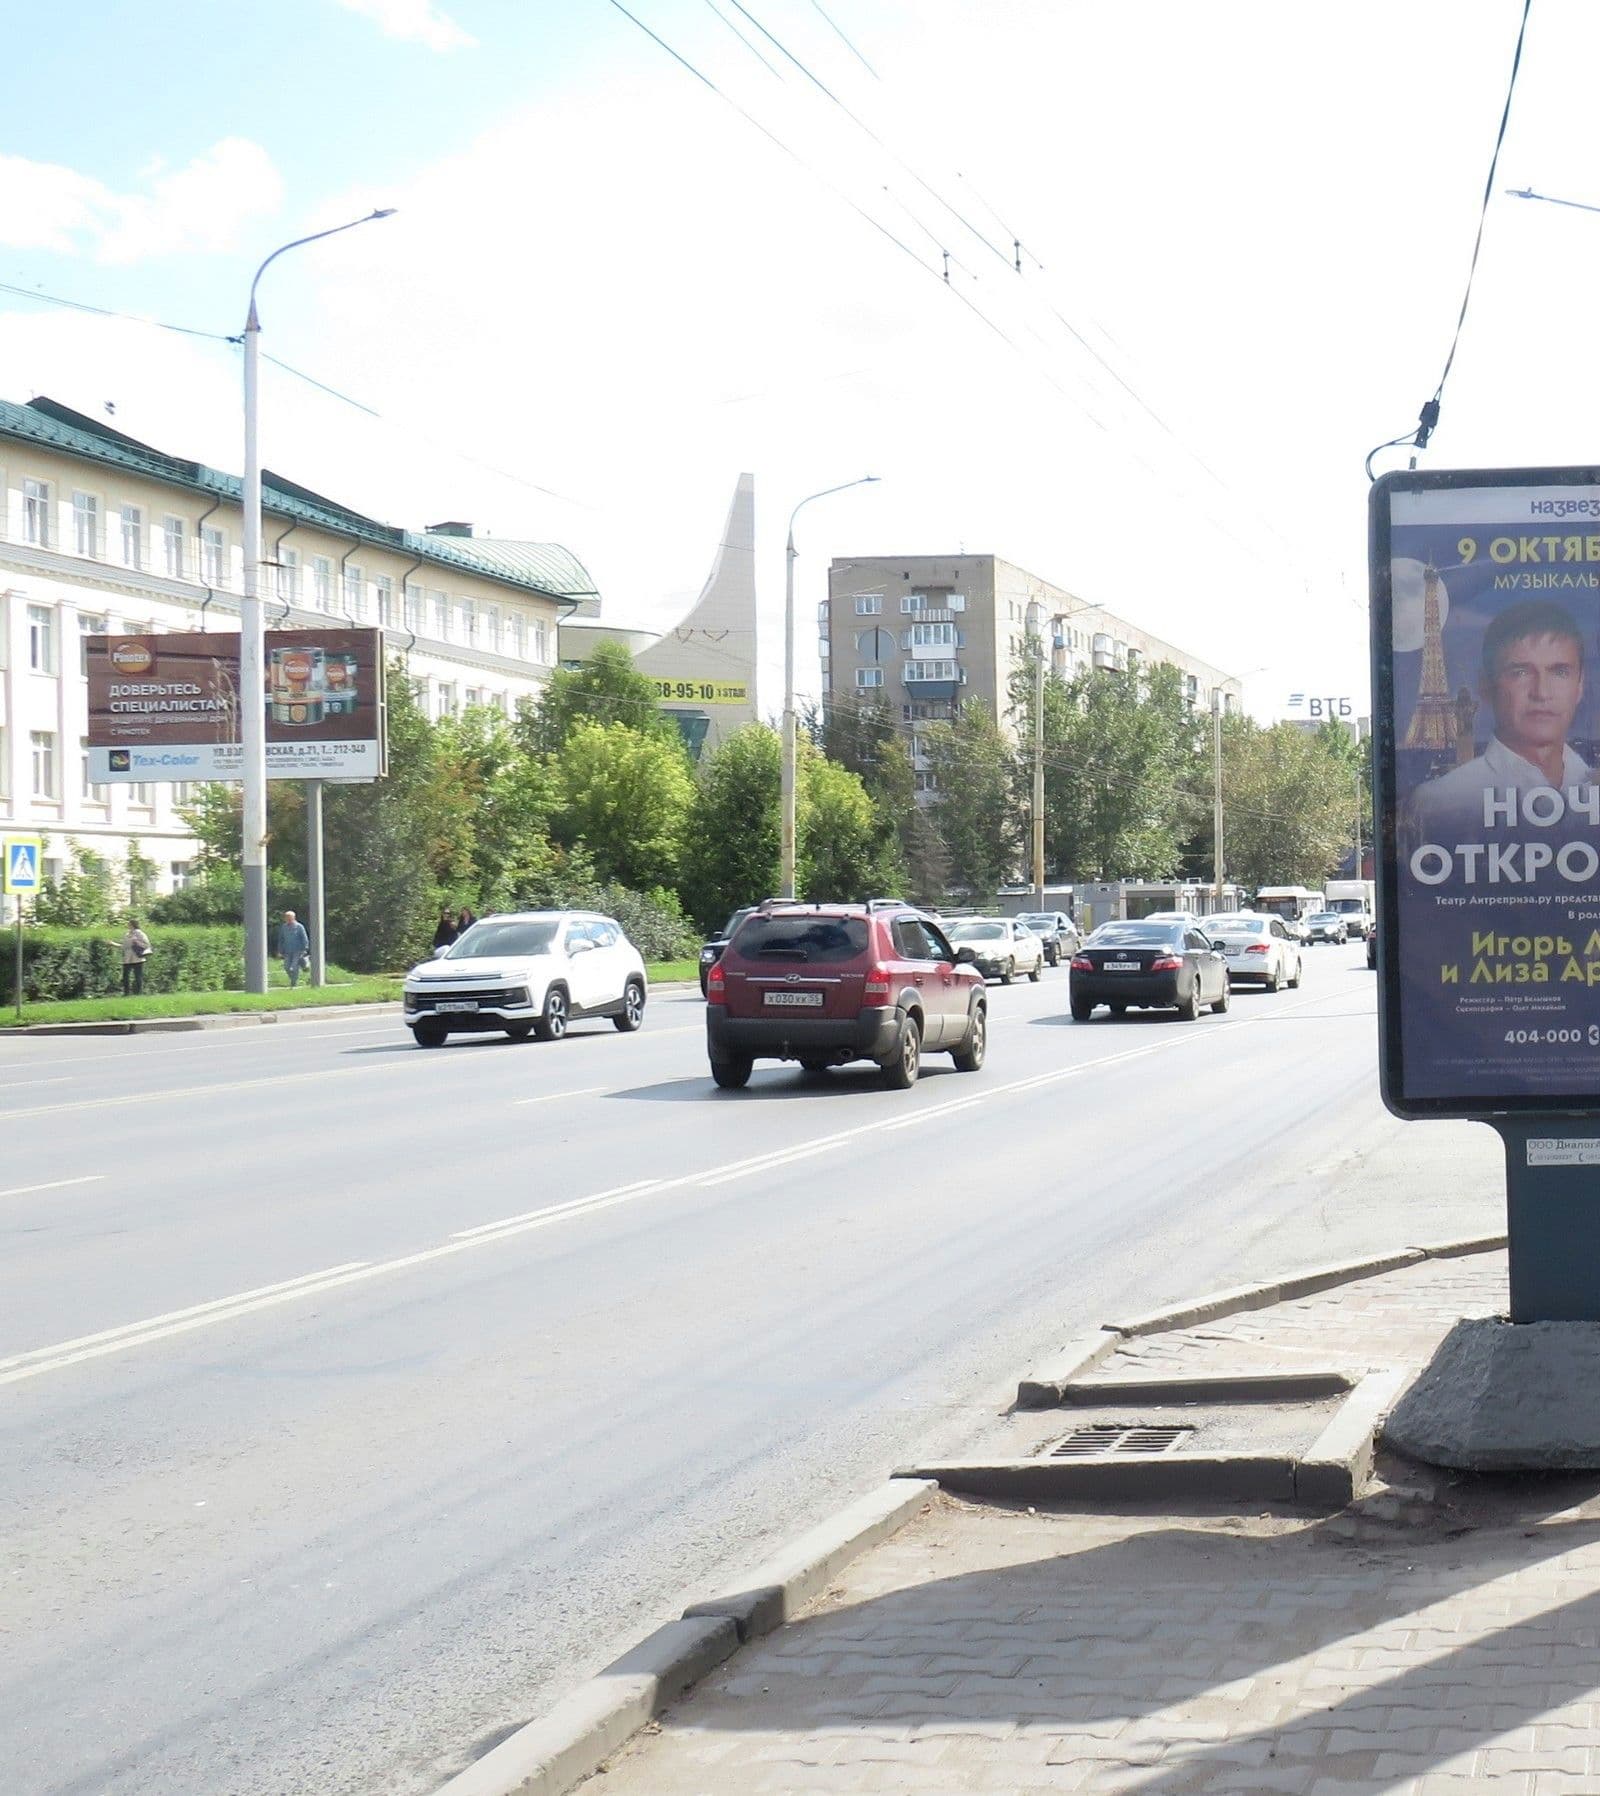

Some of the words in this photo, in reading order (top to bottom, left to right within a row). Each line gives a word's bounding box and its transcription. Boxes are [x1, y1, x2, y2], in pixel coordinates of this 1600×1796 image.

[1457, 537, 1477, 565] 9
[109, 683, 202, 698] ДОВЕРЬТЕСЬ
[110, 699, 227, 714] СПЕЦИАЛИСТАМ
[1309, 698, 1352, 717] ВТБ
[133, 754, 200, 767] Tex-Color
[1435, 895, 1466, 907] Театр
[1469, 895, 1552, 906] Антреприза.ру
[1568, 910, 1575, 919] В
[1472, 930, 1574, 961] Игорь
[1441, 963, 1459, 984] и
[1469, 957, 1550, 984] Лиза
[1504, 1029, 1581, 1044] 404-000
[1528, 1140, 1554, 1150] ООО
